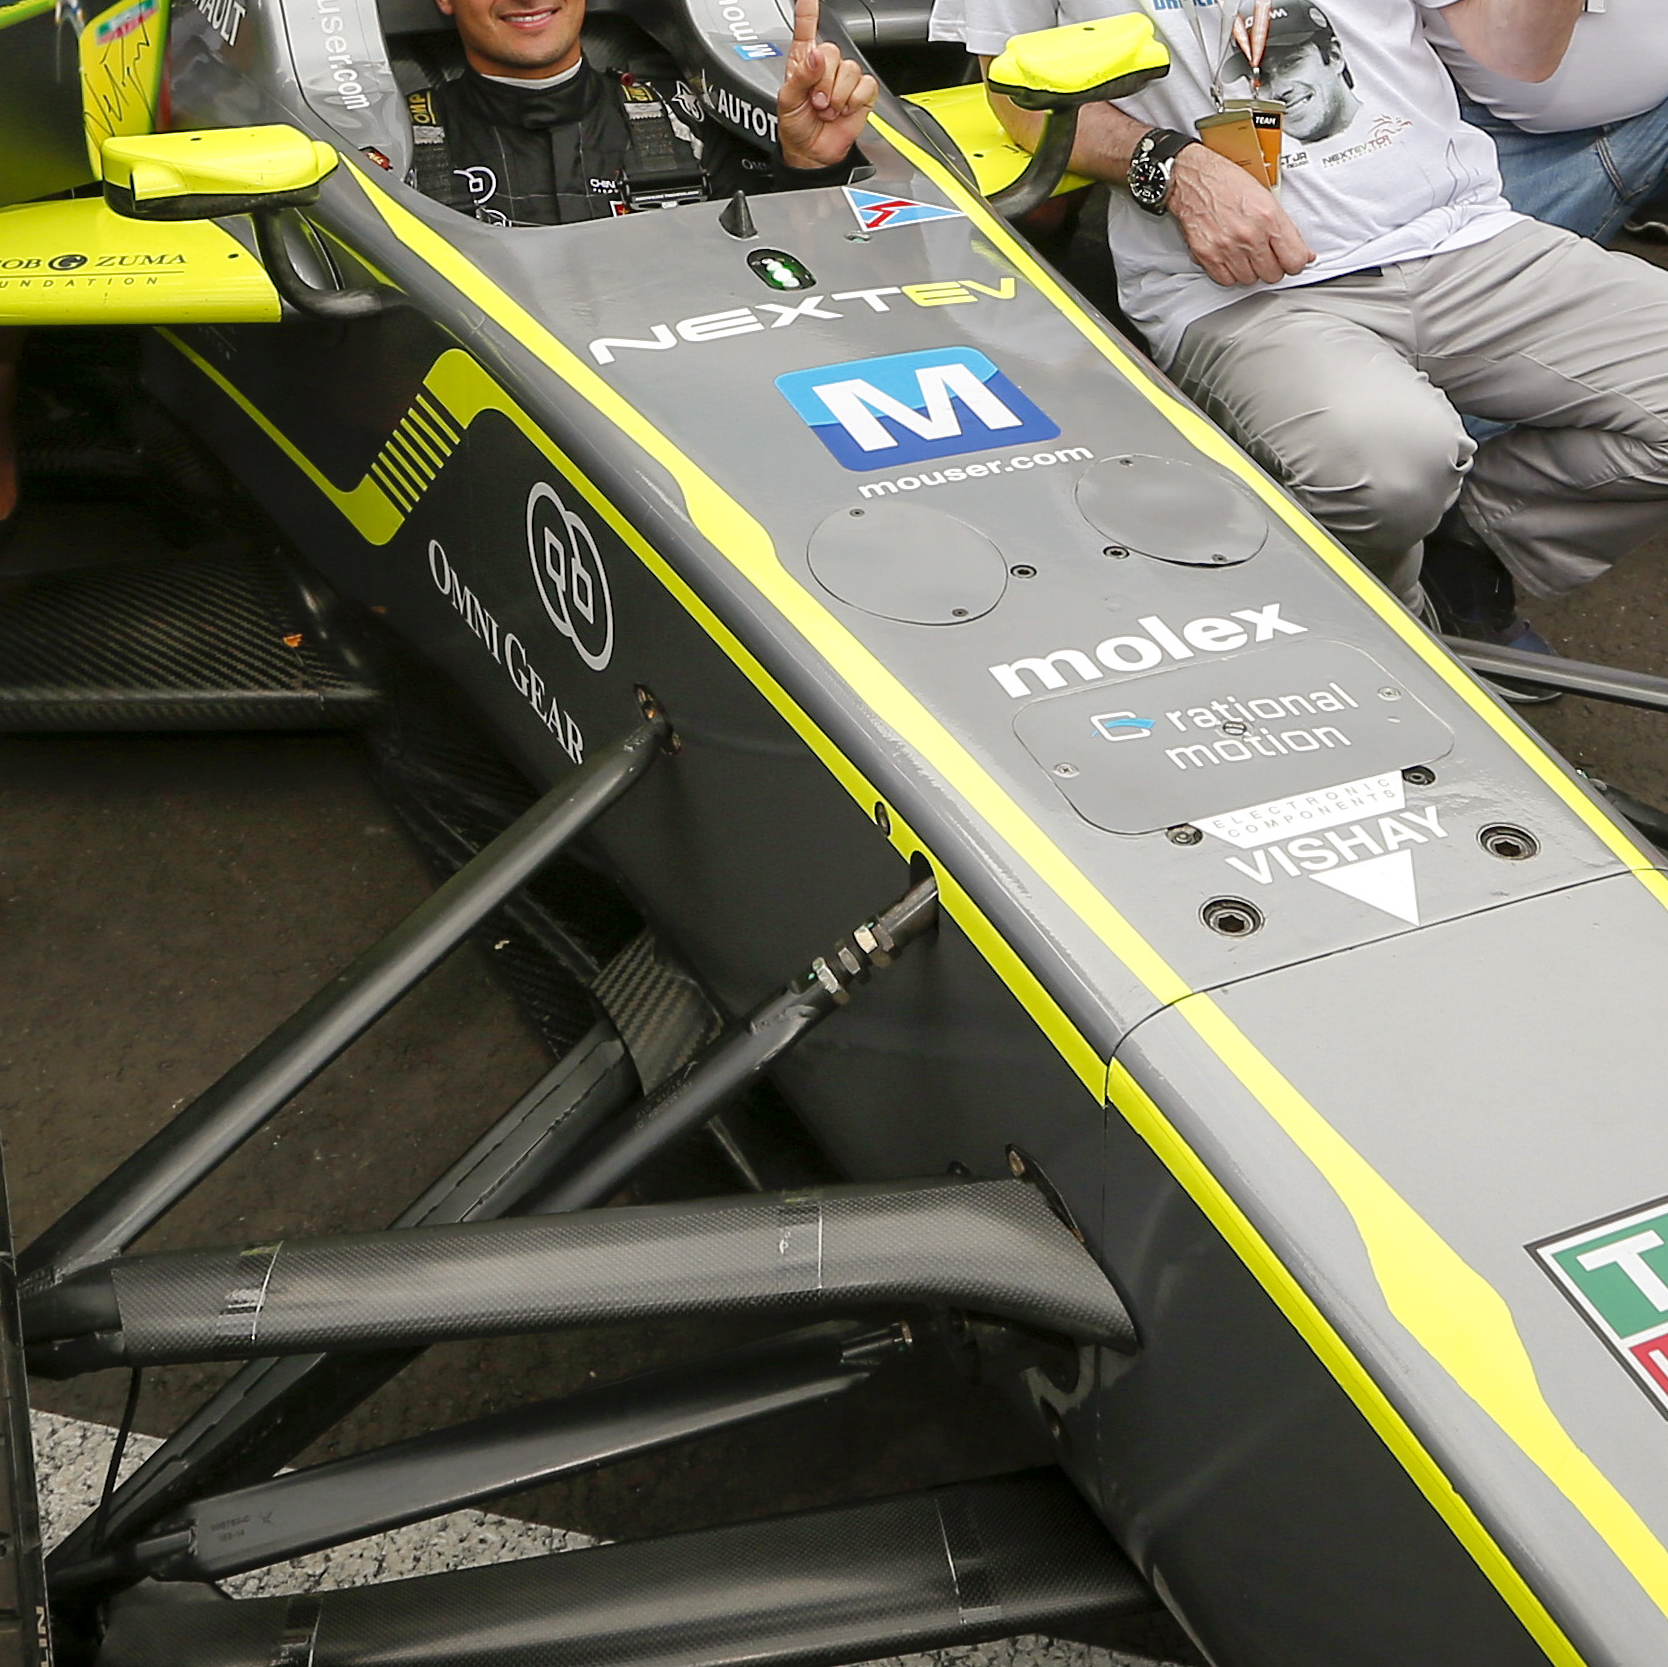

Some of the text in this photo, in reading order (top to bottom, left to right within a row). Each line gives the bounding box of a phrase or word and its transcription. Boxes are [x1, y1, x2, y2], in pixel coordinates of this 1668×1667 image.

[717, 88, 779, 143] AUTOT
[1255, 116, 1276, 126] TEAM
[95, 253, 189, 267] ZUMA
[588, 275, 1018, 366] NEXTEV
[821, 363, 1024, 453] M
[858, 445, 1095, 500] mouser.com
[428, 539, 584, 766] OMNI GEAR
[987, 600, 1309, 701] molex
[1165, 679, 1358, 738] rational
[1164, 716, 1353, 771] motion
[1213, 777, 1391, 830] ELECTRONIC
[1227, 789, 1397, 839] COMPONENTS
[1224, 804, 1449, 885] VISHAY
